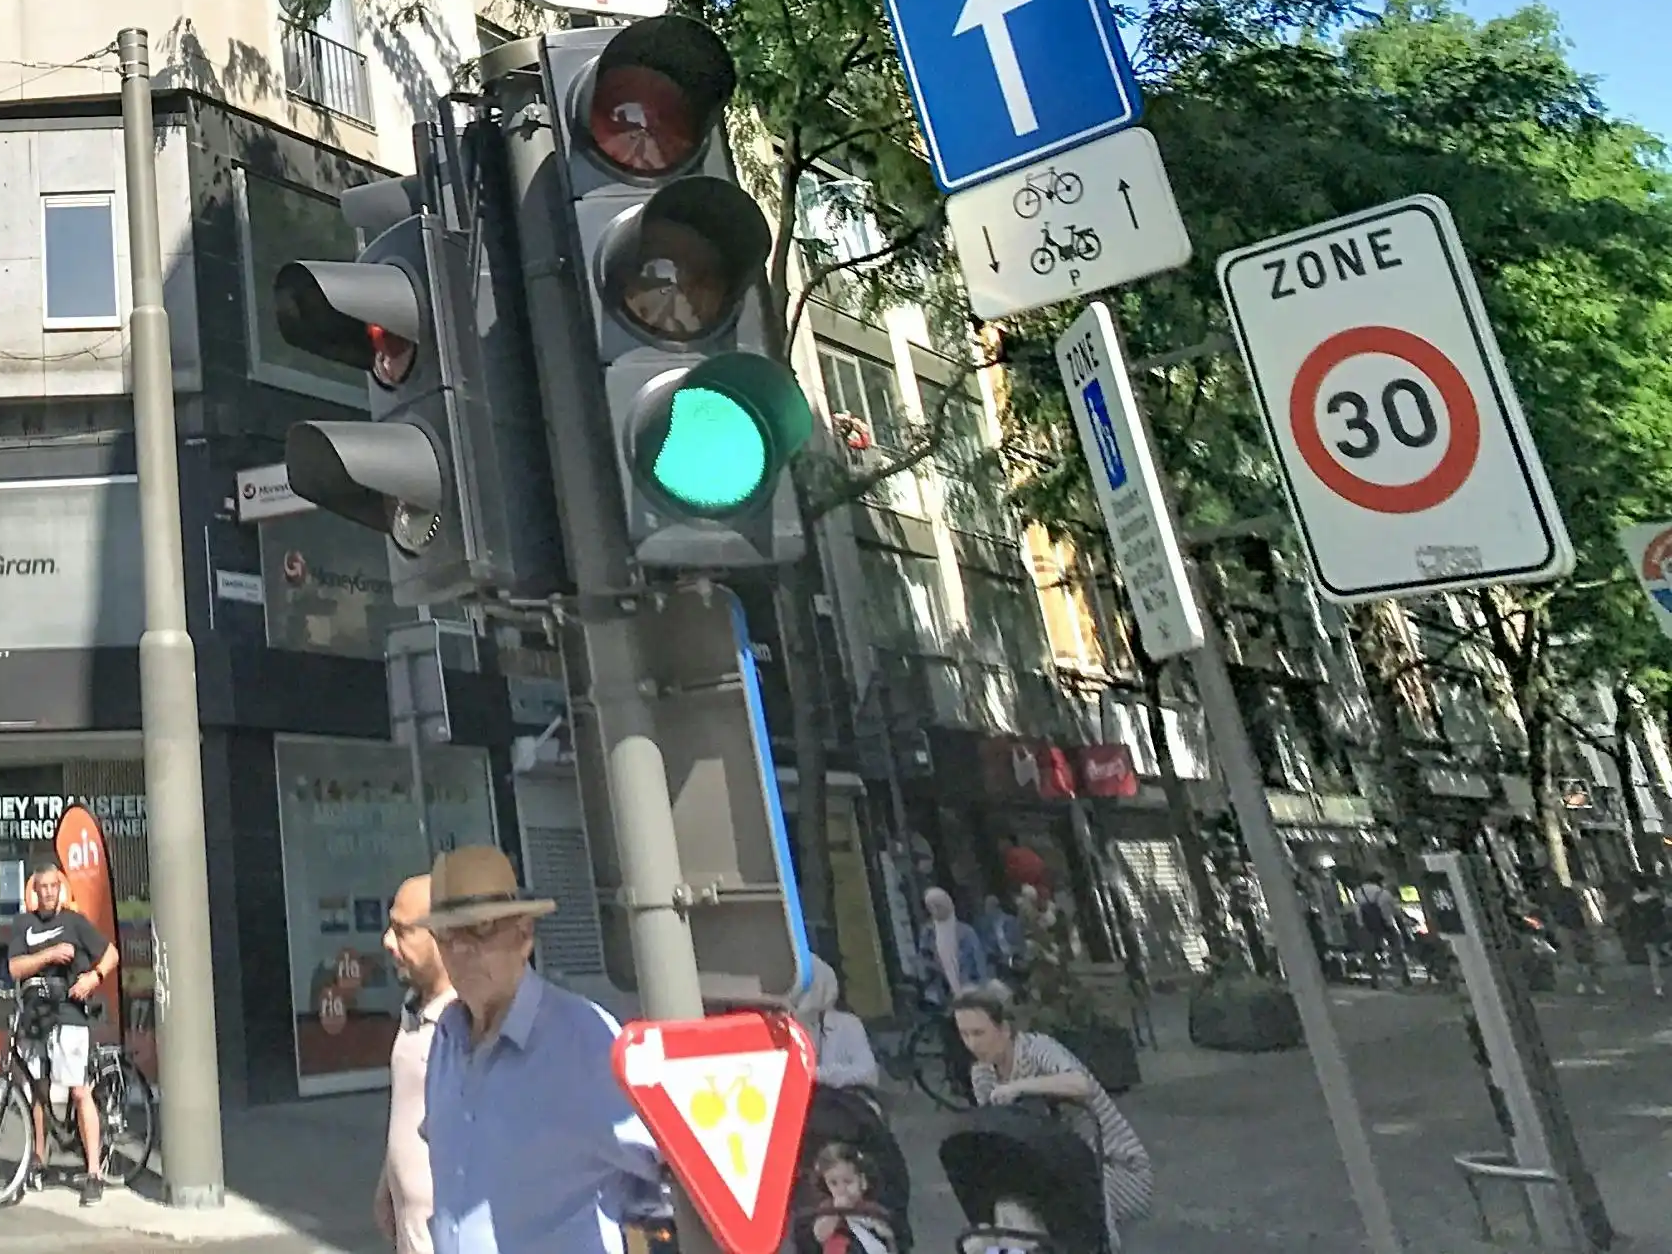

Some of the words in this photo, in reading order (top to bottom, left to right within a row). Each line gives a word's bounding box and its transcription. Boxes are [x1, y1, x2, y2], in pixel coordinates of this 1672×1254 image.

[1069, 269, 1080, 287] P
[1262, 227, 1403, 300] ZONE
[1066, 331, 1100, 387] ZONE
[1326, 377, 1438, 460] 30
